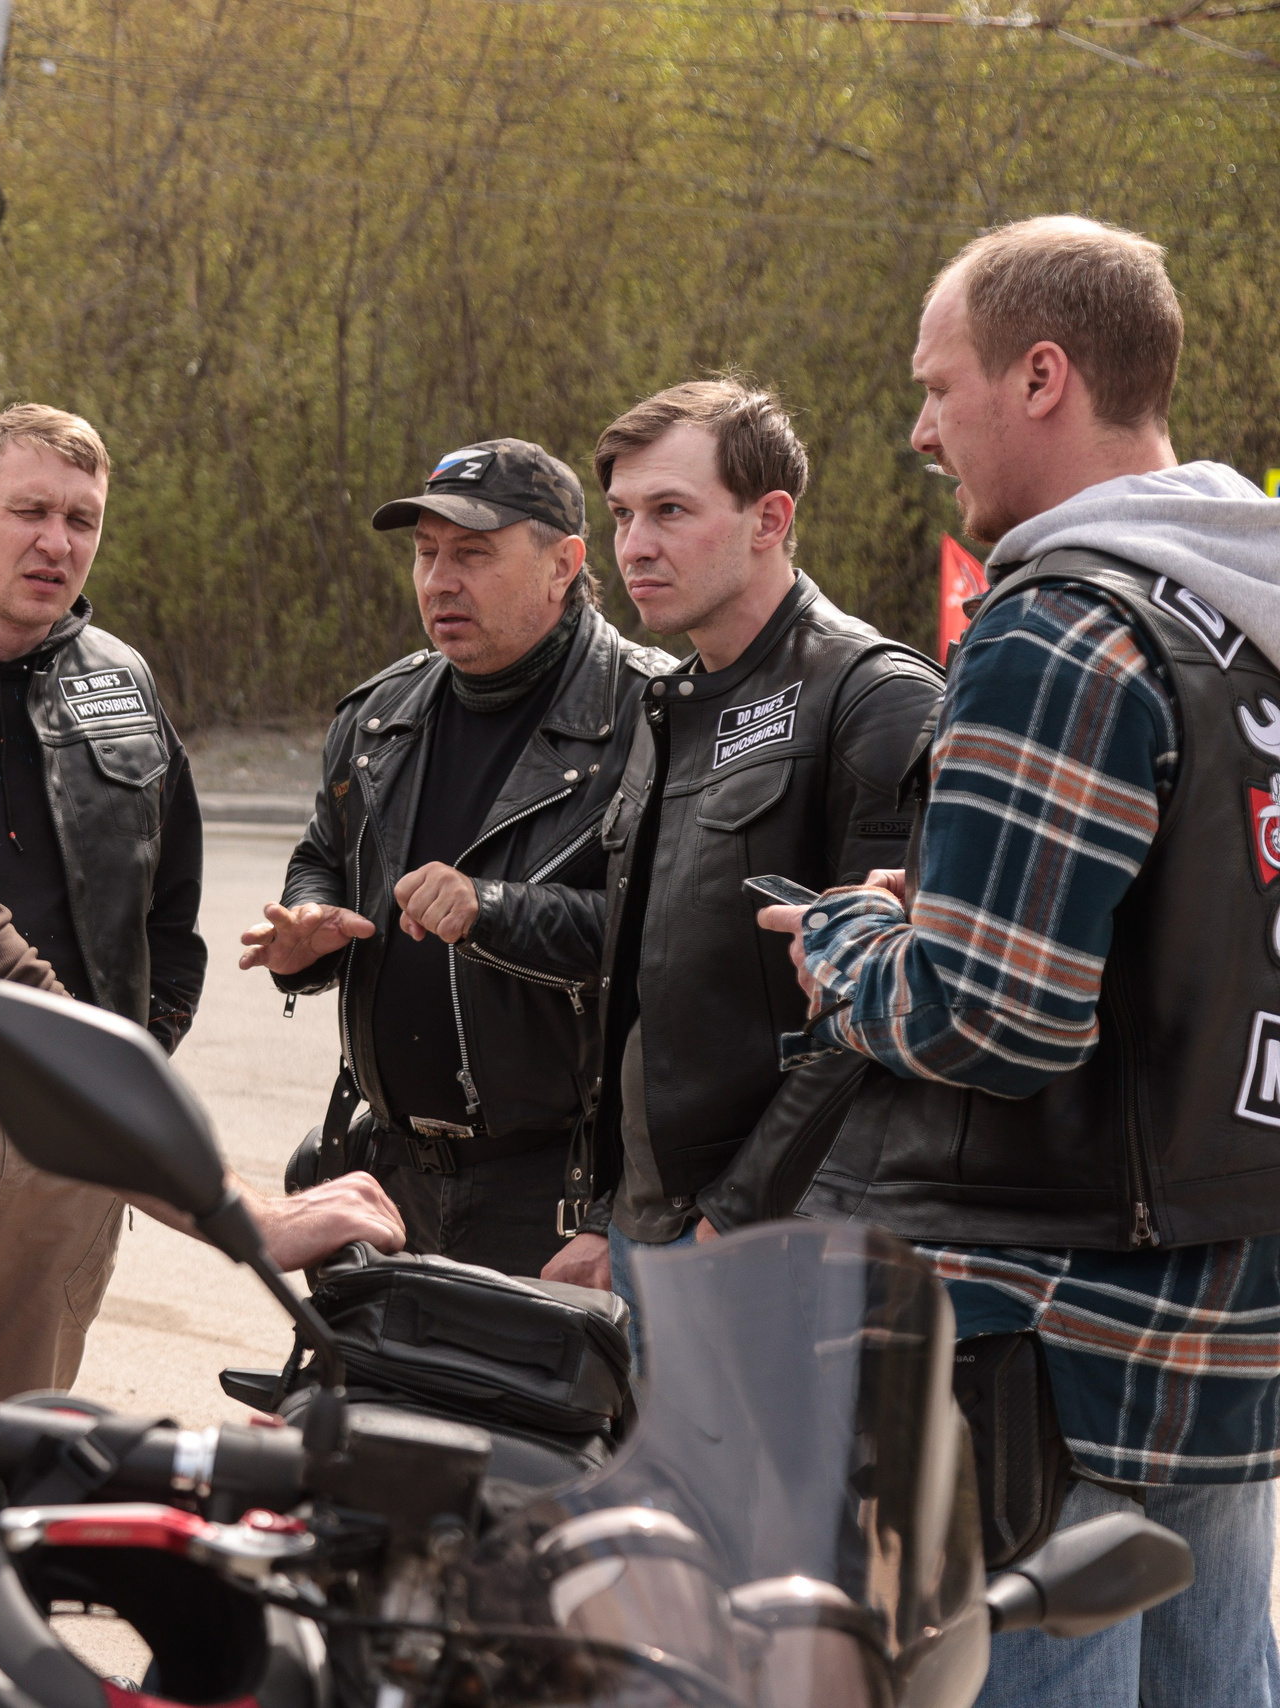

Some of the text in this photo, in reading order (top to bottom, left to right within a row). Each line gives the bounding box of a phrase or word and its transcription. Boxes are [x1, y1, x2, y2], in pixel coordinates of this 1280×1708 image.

[459, 461, 482, 479] Z
[72, 673, 121, 693] DD BIKE'S
[76, 696, 141, 717] NOVOSIBIRSK
[736, 694, 786, 726] DD BIKE'S
[720, 719, 787, 761] NOVOSIBIRSK
[858, 822, 912, 833] FIELDSH
